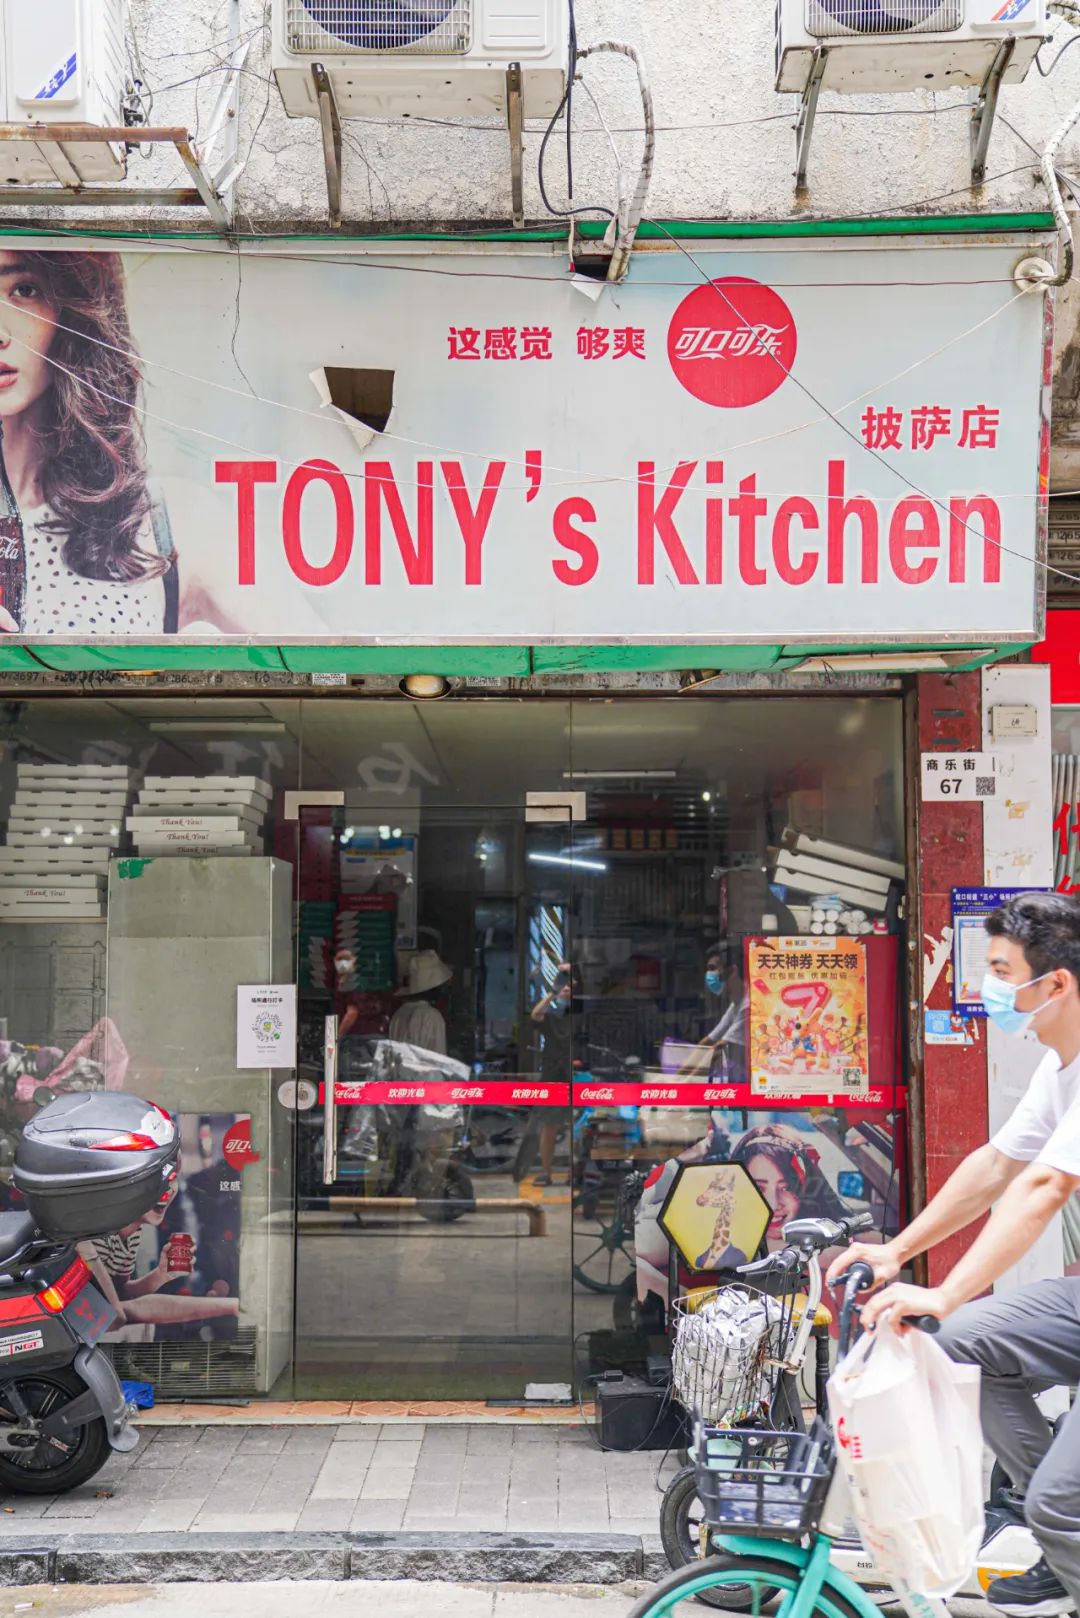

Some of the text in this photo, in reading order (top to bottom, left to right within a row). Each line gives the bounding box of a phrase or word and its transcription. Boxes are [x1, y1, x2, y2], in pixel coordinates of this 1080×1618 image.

[448, 326, 646, 360] 这感觉 够爽
[675, 323, 790, 360] 可口可乐
[861, 404, 1000, 450] 披萨店
[637, 460, 1001, 587] Kitchen
[926, 759, 976, 771] 商乐街
[940, 778, 963, 795] 67
[160, 817, 203, 827] Thank You!
[166, 832, 209, 841] Thank You!
[176, 846, 218, 855] Thank You!
[24, 889, 66, 898] Thank You!
[757, 953, 858, 970] 天天神券 天天领
[334, 1087, 549, 1099] oca-Cola 欢迎光临 可口可乐 欢迎光临
[580, 1087, 615, 1100] Coca-Cola
[640, 1089, 678, 1099] 欢迎光临
[703, 1088, 739, 1100] 可口可乐
[14, 1341, 38, 1353] NGT
